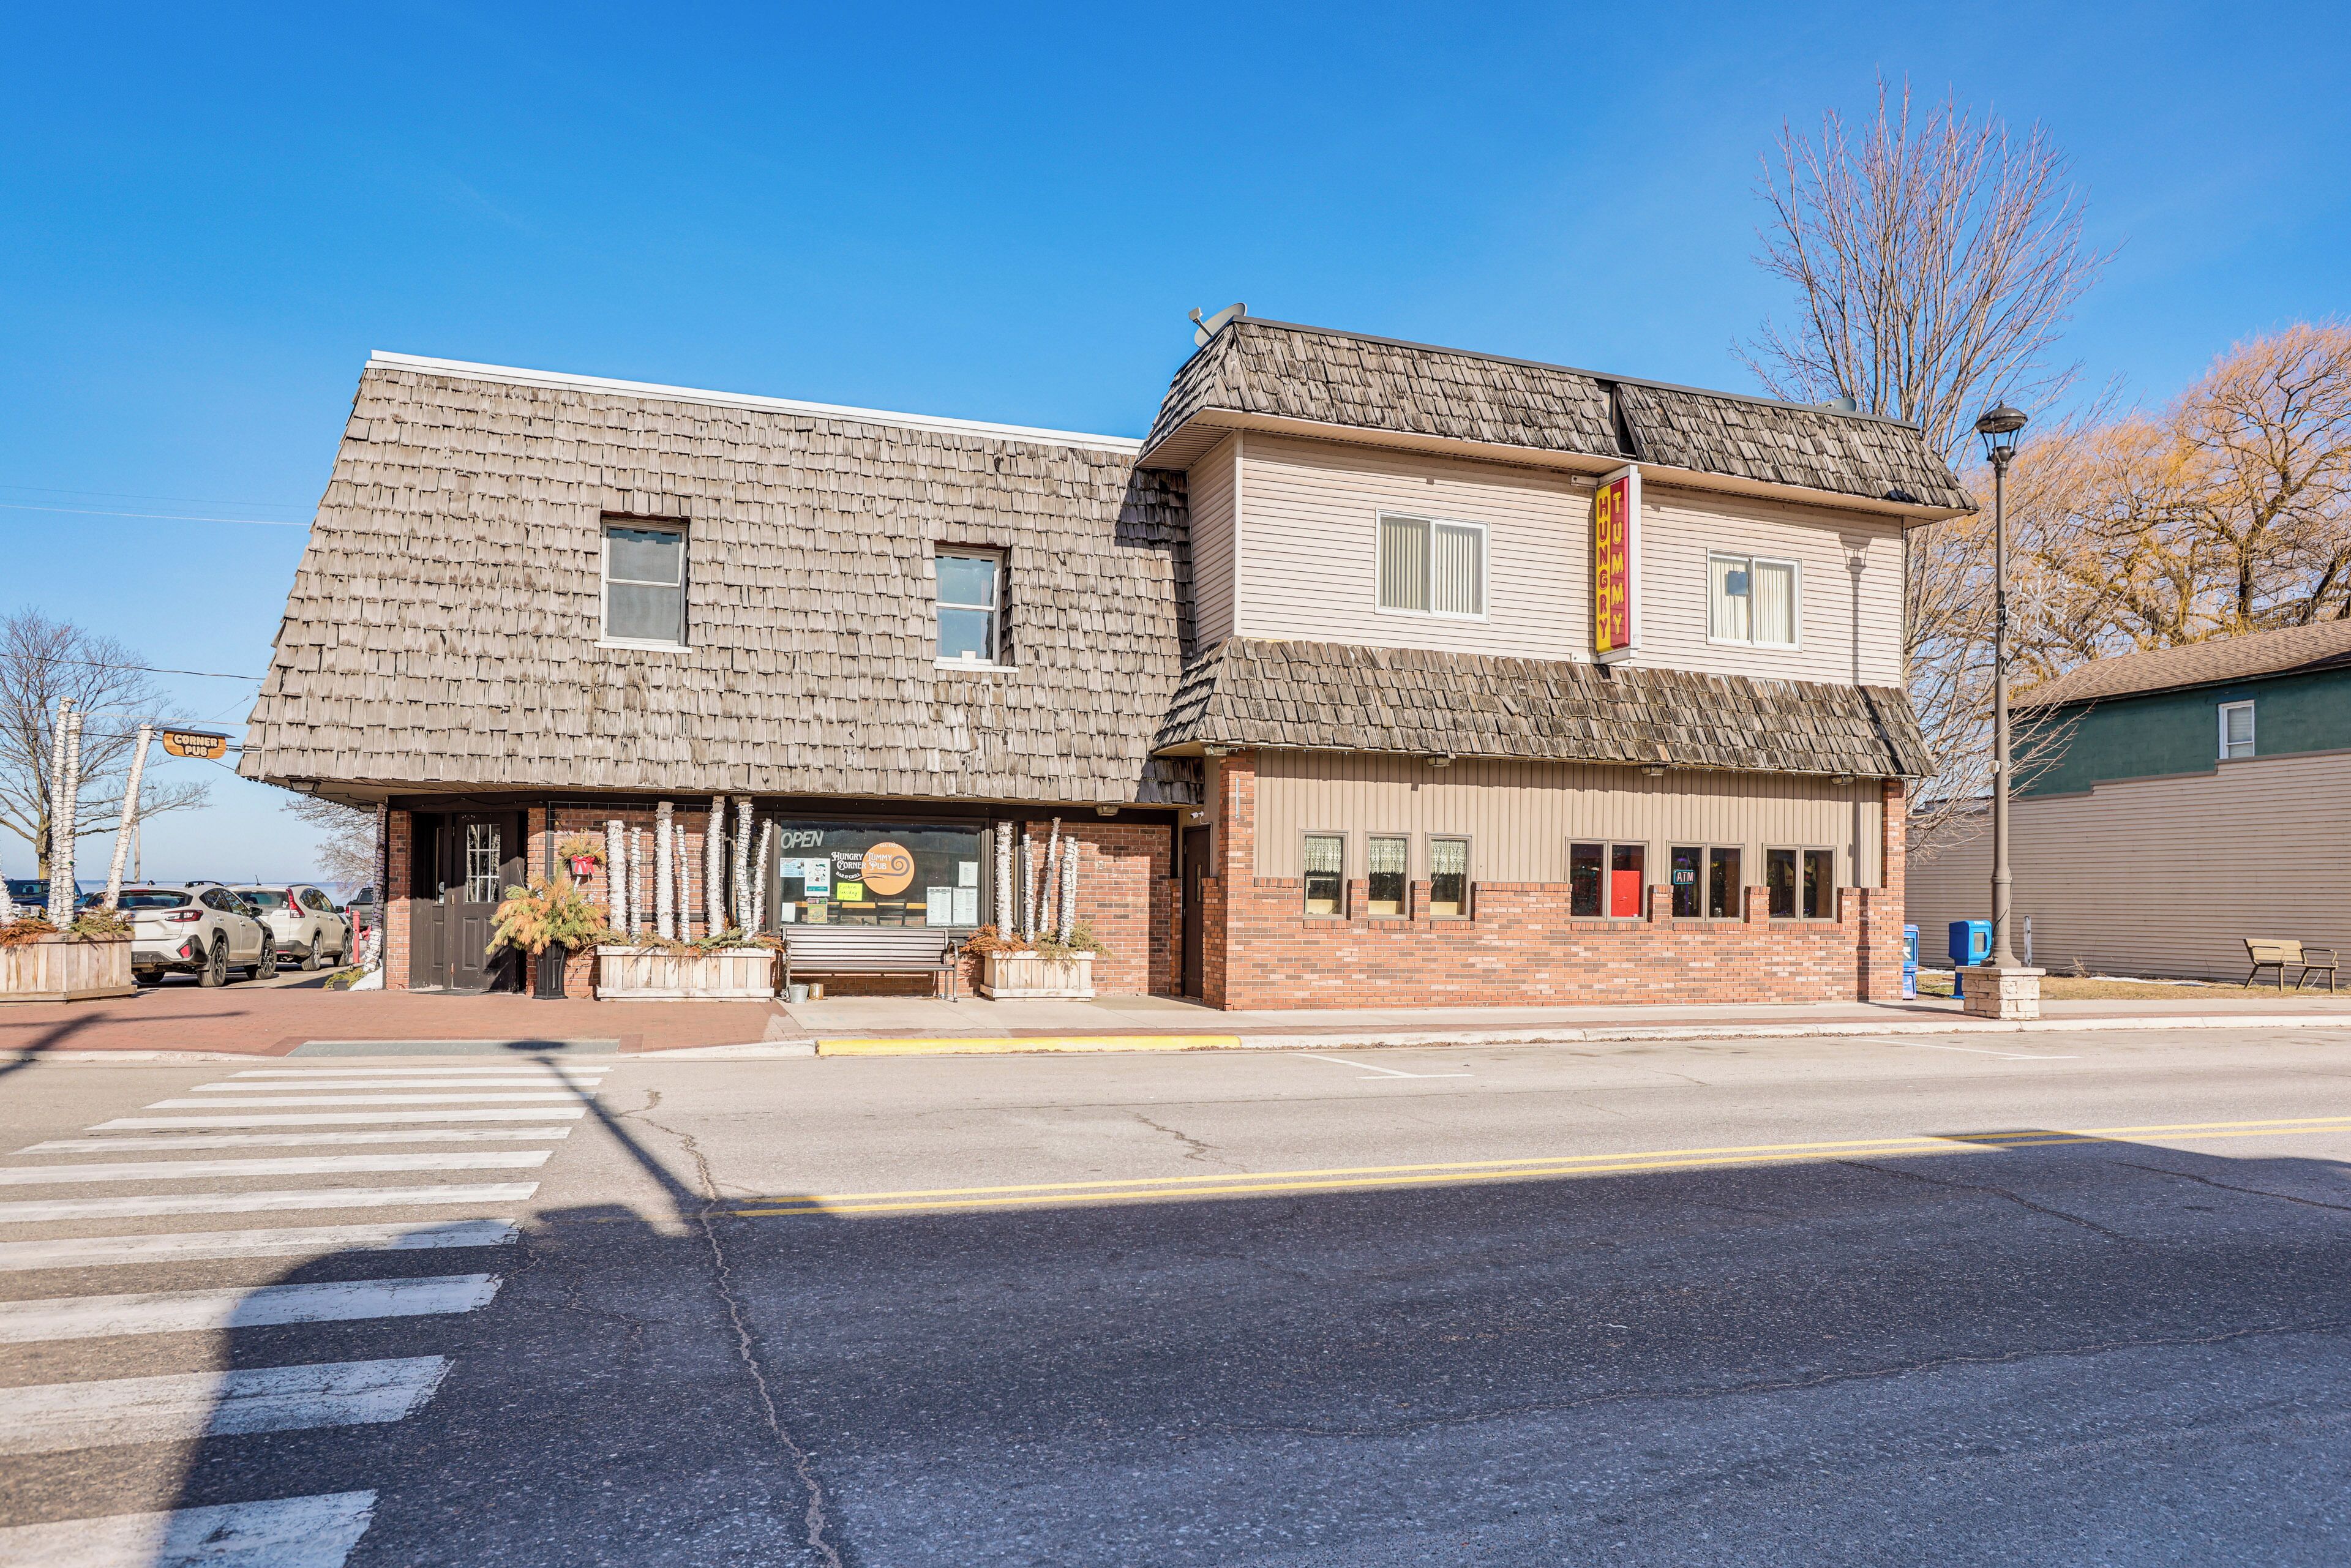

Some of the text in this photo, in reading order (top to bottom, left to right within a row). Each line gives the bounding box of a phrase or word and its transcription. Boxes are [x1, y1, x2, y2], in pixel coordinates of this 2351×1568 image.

[1599, 498, 1608, 639] HUNGRY
[1611, 491, 1624, 635] TUMMY
[174, 734, 217, 747] CORNER
[185, 745, 208, 757] PUB
[781, 830, 825, 849] OPEN
[831, 852, 893, 862] HUNGRY TUMMY
[836, 860, 887, 871] CORNER PUB
[1676, 871, 1694, 882] ATM
